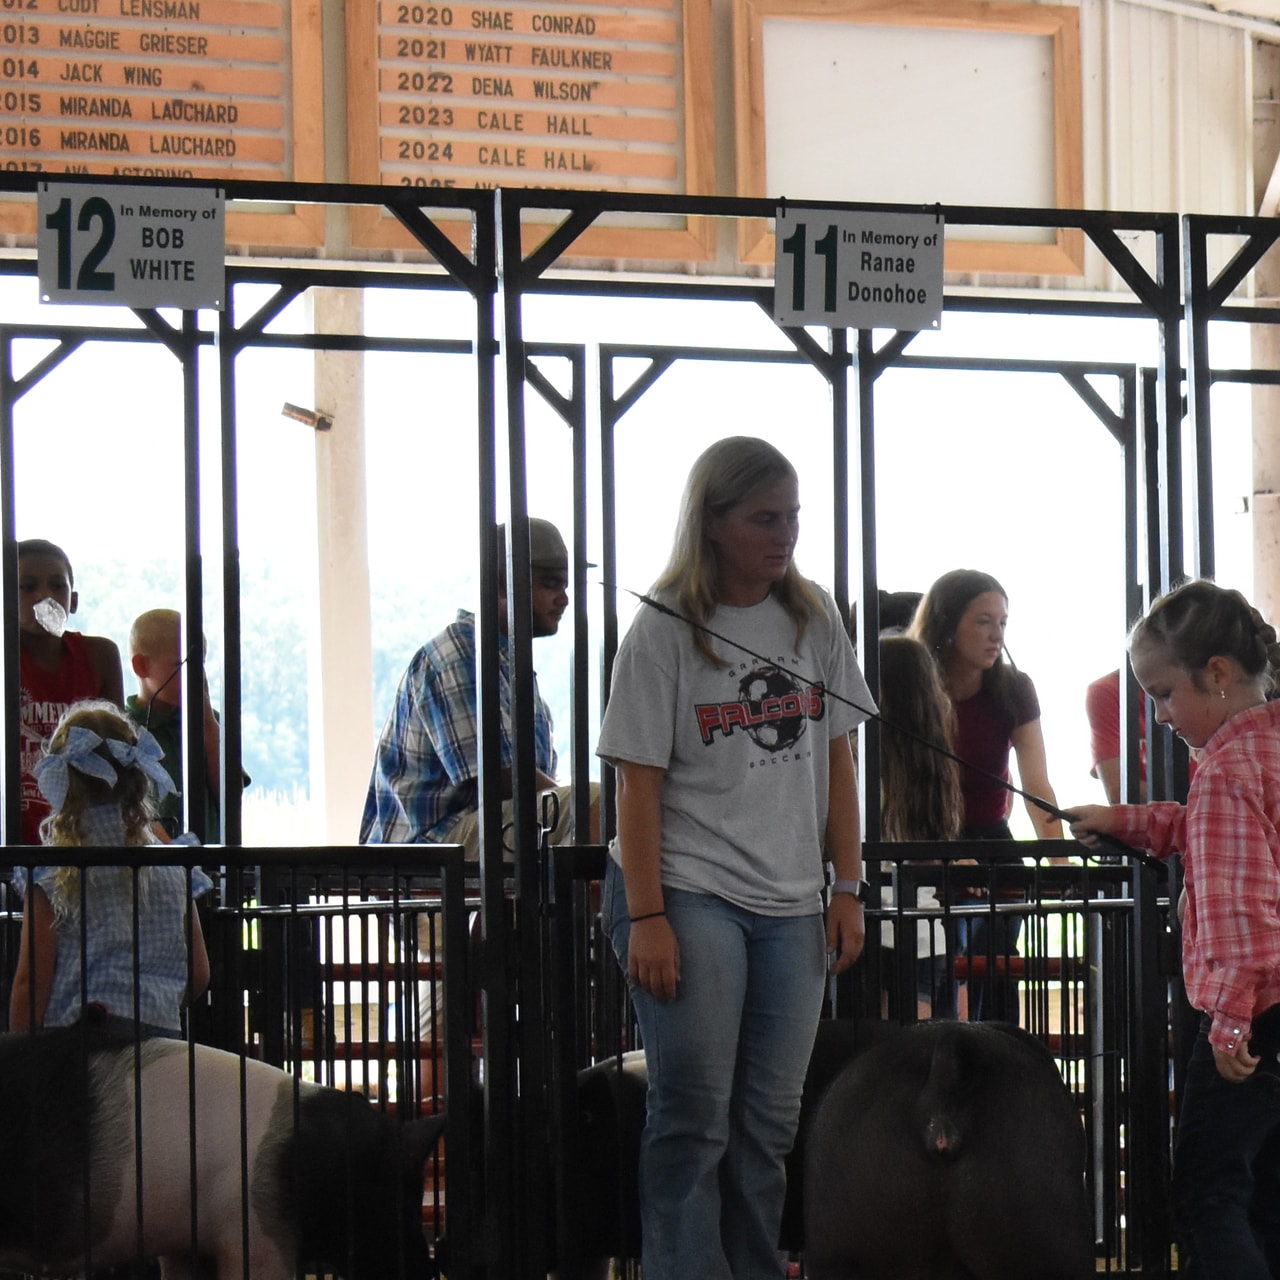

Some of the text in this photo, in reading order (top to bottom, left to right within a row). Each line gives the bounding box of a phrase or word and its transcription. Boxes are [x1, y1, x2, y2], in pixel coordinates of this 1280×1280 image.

[119, 0, 201, 20] LENSMAN
[398, 6, 596, 35] 2020 SHAE CONRAD
[1, 24, 208, 55] 013 MAGGIE GRIESER
[398, 39, 612, 71] 2021 WYATT FAULKNER
[2, 58, 162, 87] 014 JACK WING
[398, 73, 592, 101] 2022 DENA WILSON
[0, 92, 239, 123] 015 MIRANDA LAUCHARD
[399, 107, 592, 136] 2023 CALE HALL
[61, 131, 130, 152] MIRANDA
[150, 136, 236, 157] LAUCHARD
[399, 141, 593, 171] 2024 CALE HALL
[0, 161, 42, 173] 017
[121, 205, 216, 221] In Memory of
[46, 196, 116, 291] 12
[142, 227, 184, 249] BOB
[843, 230, 937, 249] In Memory of
[130, 259, 195, 281] WHITE
[783, 223, 838, 312] 11
[861, 251, 915, 273] Ranae
[848, 281, 926, 304] Donohoe
